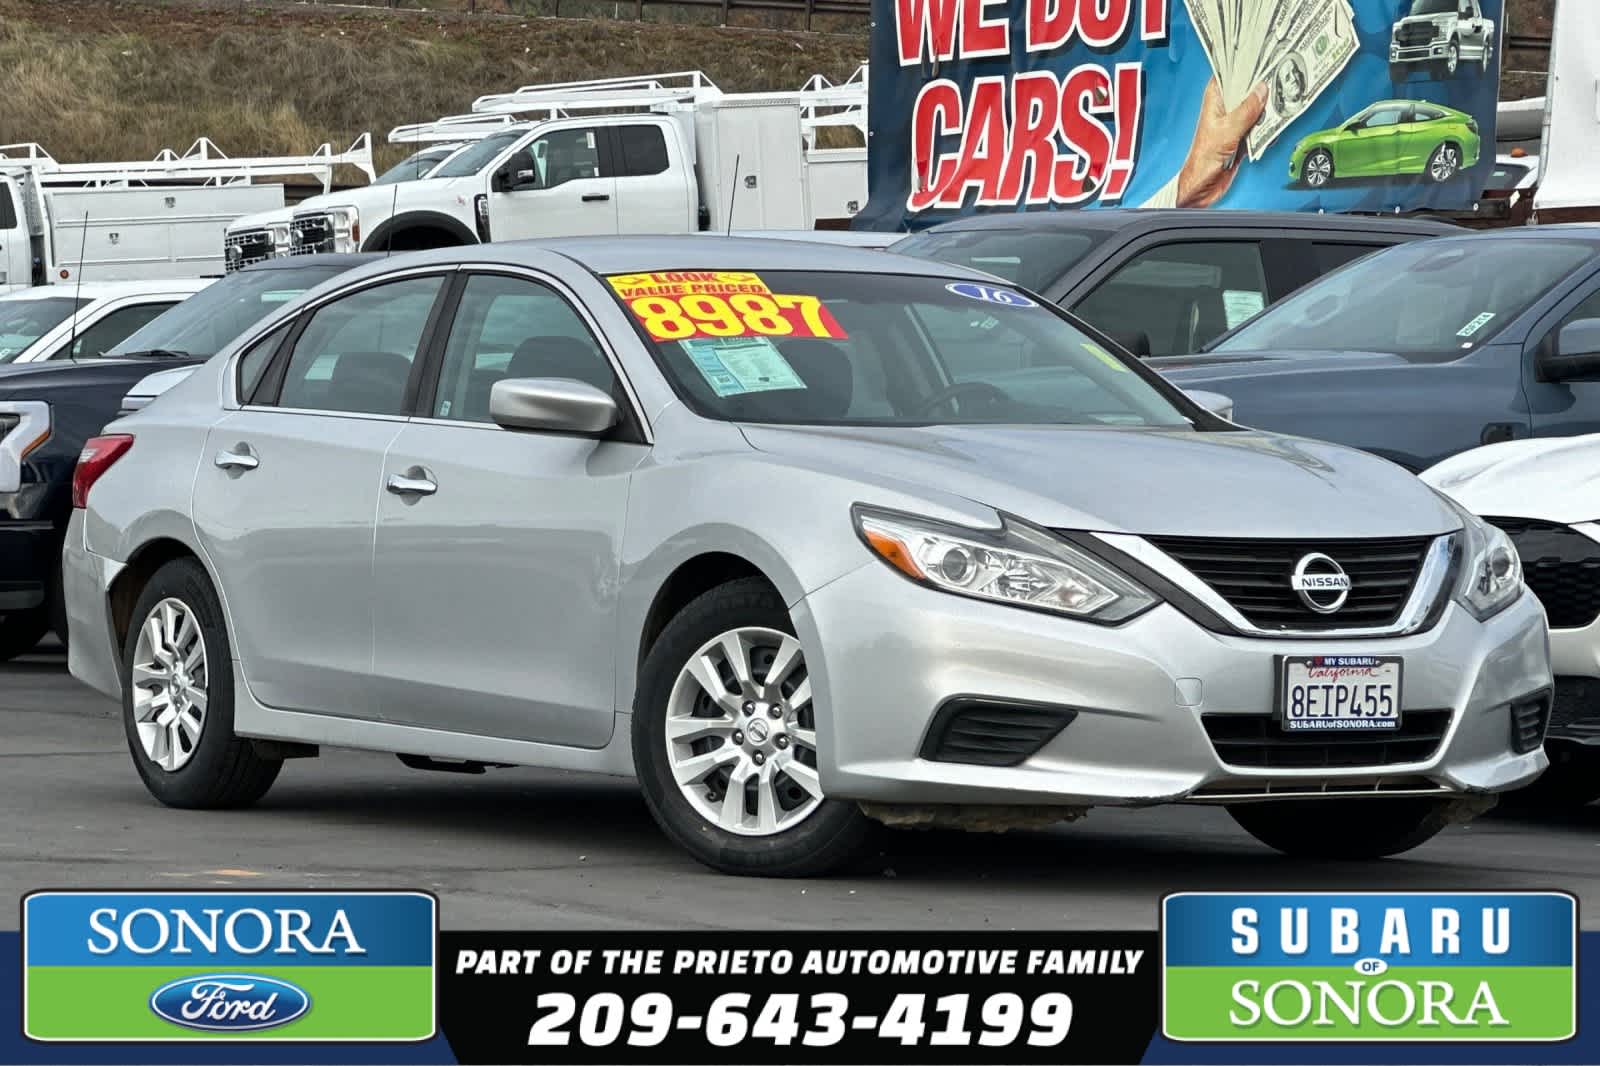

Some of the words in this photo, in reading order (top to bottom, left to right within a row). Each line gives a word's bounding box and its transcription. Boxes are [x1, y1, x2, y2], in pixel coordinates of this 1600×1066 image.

[906, 62, 1142, 212] CARS!
[651, 271, 719, 284] LOOK
[620, 284, 687, 297] VALUE
[690, 283, 766, 296] PRICED
[978, 286, 1012, 304] 16
[631, 293, 832, 340] 8987
[1301, 577, 1348, 588] NISSAN
[1324, 657, 1337, 666] MY
[1338, 656, 1375, 666] SUBARU
[1308, 667, 1379, 683] California
[1291, 684, 1393, 718] 8EIP455
